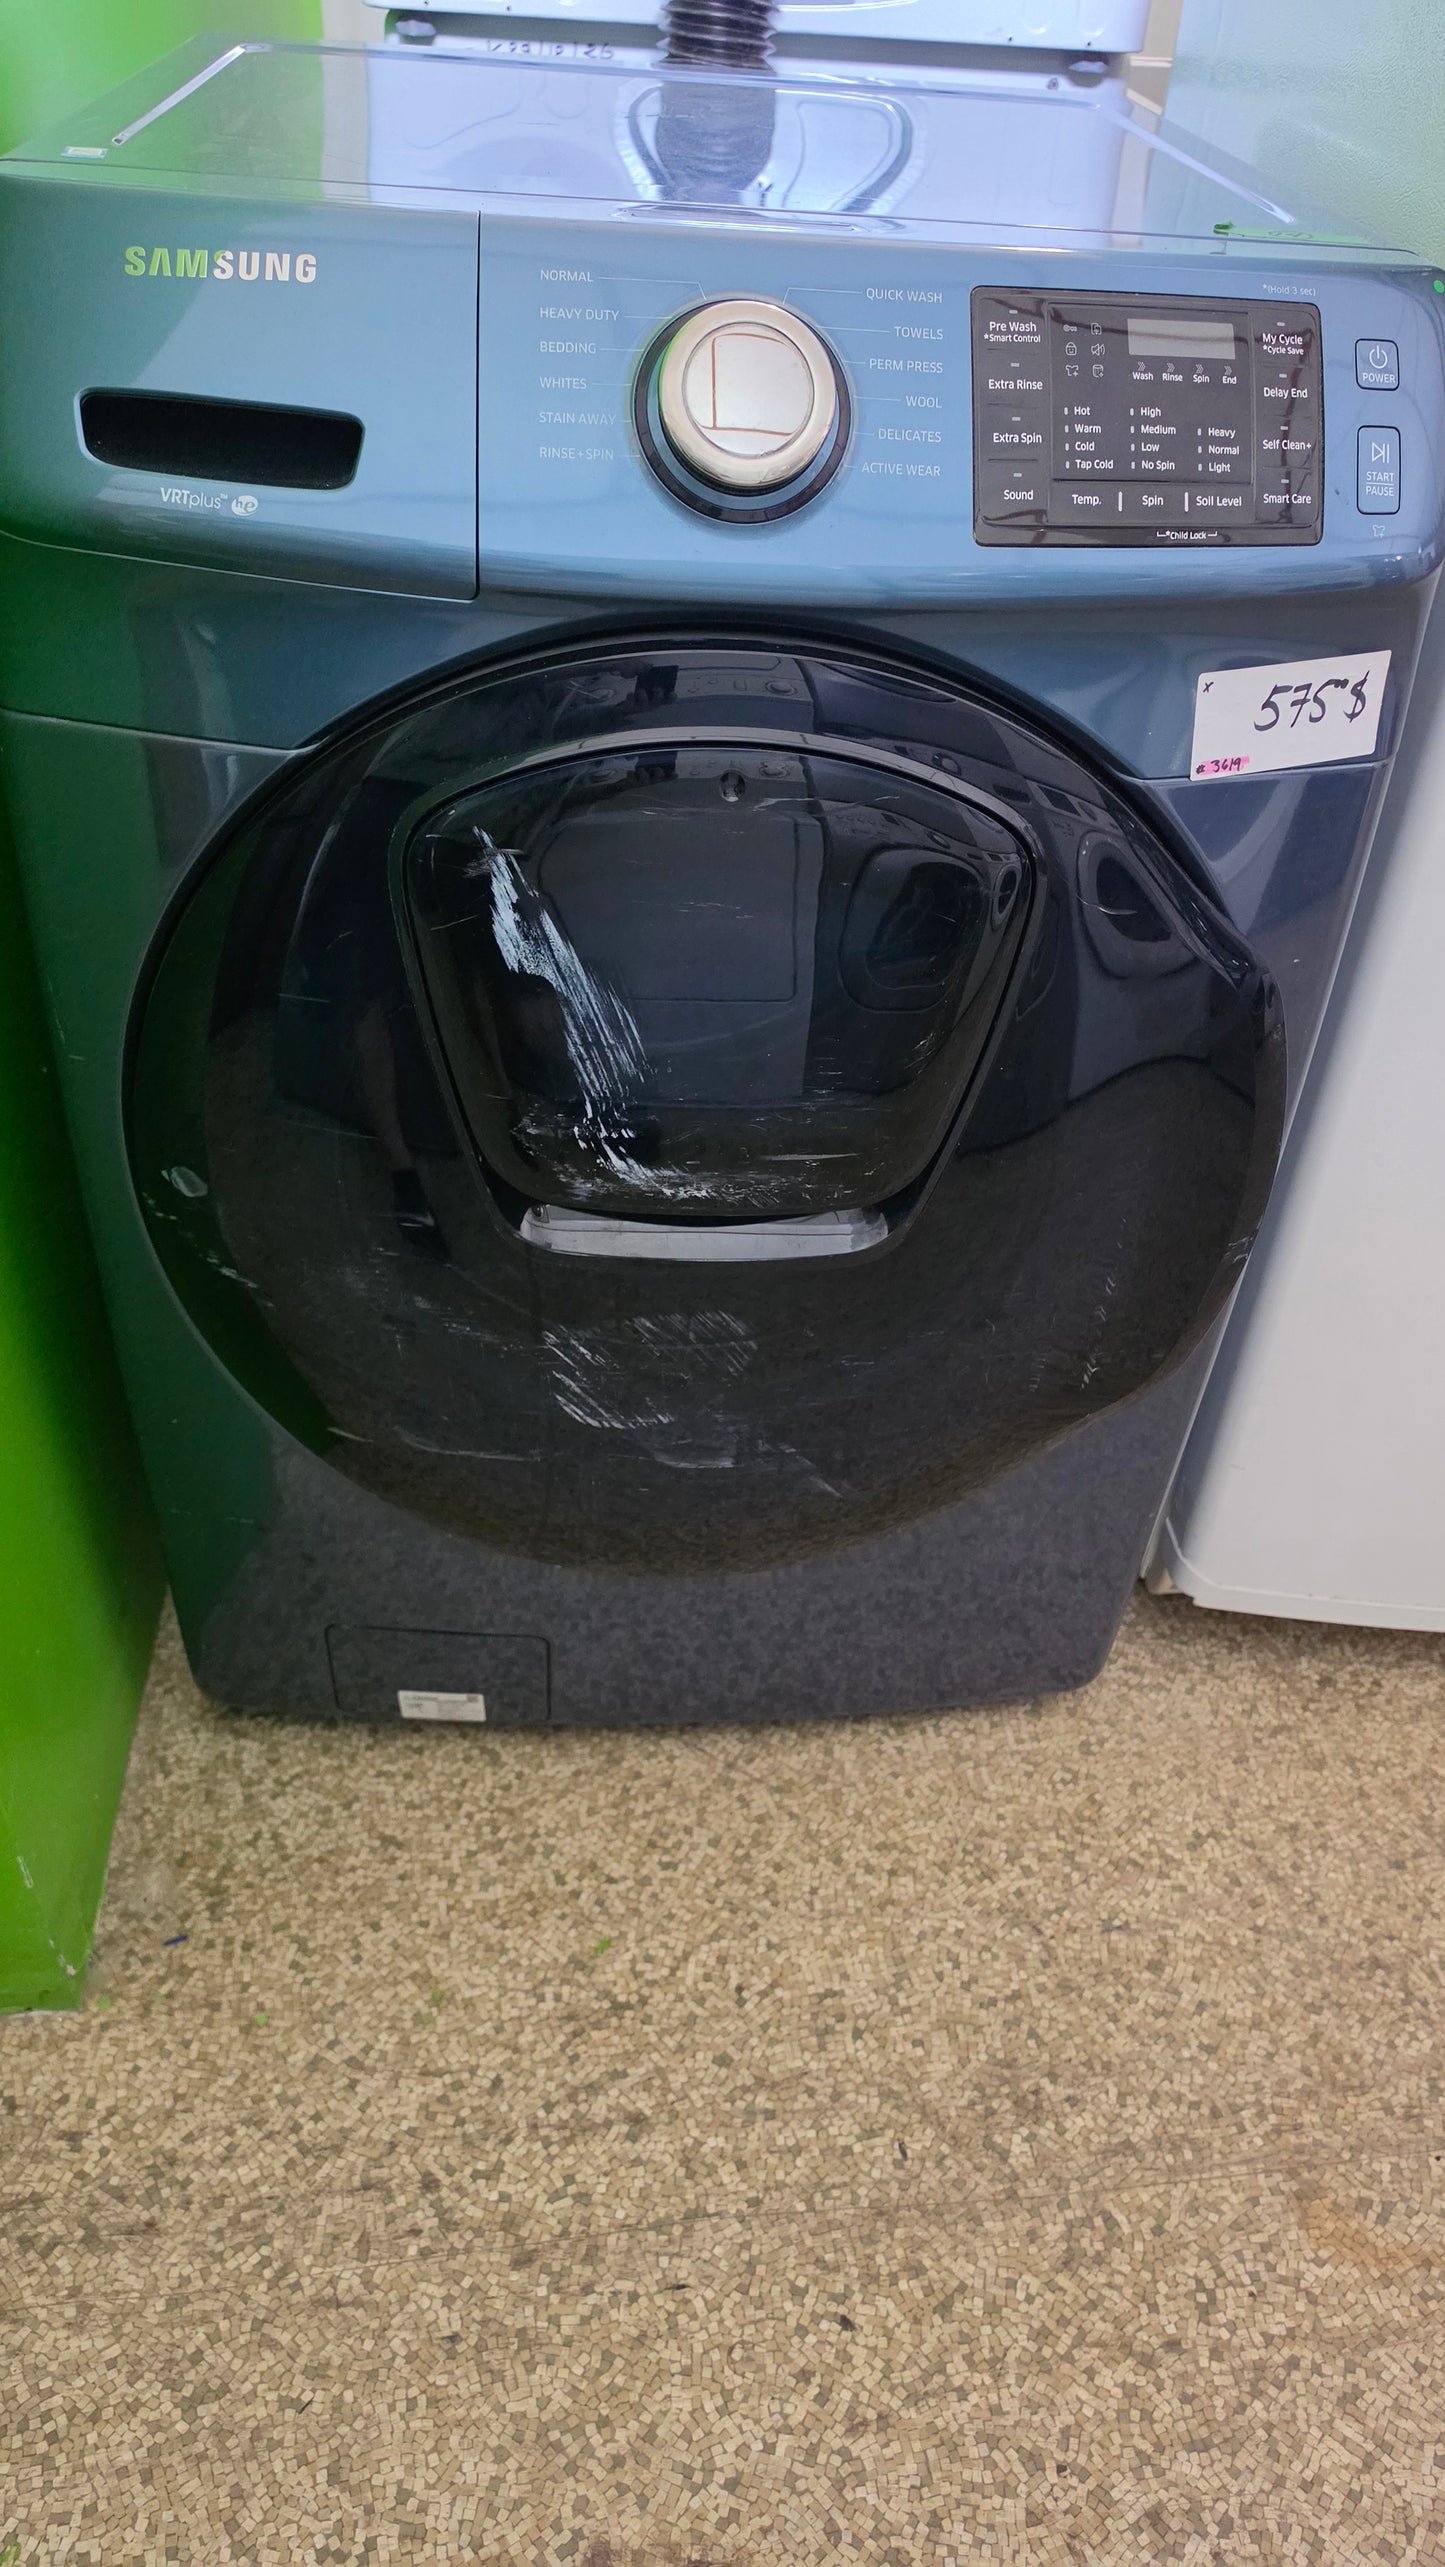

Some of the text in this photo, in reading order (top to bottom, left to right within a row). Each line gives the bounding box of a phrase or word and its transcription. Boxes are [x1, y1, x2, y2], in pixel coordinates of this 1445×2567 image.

[124, 246, 317, 283] SAMSUNG
[540, 269, 594, 283] NORMAL
[866, 287, 943, 304] QUICK WASH
[1292, 286, 1298, 295] 3
[540, 307, 619, 321] HEAVY DUTY
[989, 321, 1037, 332] Pre Wash
[894, 326, 944, 340] TOWELS
[1013, 334, 1041, 343] Control
[1262, 333, 1303, 345] My Cycle
[540, 341, 597, 354] BEDDING
[1287, 346, 1304, 355] Save
[869, 358, 944, 374] PERM PRESS
[1132, 371, 1154, 381] Wash
[1162, 373, 1183, 382] Rinse
[1193, 374, 1210, 384] Spin
[1222, 376, 1237, 385] End
[1362, 372, 1396, 384] POWER
[540, 376, 588, 390] WHITES
[988, 379, 1043, 390] Extra Rinse
[1263, 387, 1308, 400] Delay End
[905, 395, 943, 409] WOOL
[1073, 406, 1091, 416] Hot
[1140, 407, 1162, 418] High
[539, 411, 617, 425] STAIN AWAY
[1074, 424, 1102, 434] Warm
[1140, 425, 1177, 435] Medium
[1208, 427, 1236, 439] Heavy
[878, 428, 942, 443] DELICATES
[993, 432, 1042, 445] Extra Spin
[1075, 442, 1095, 452] Cold
[1141, 442, 1160, 452] Low
[1208, 445, 1240, 455] Normal
[1262, 439, 1312, 451] Self Clean+
[861, 461, 941, 477] ACTIVE WEAR
[1075, 460, 1114, 470] Tap Cold
[1141, 460, 1176, 471] No Spin
[1208, 462, 1231, 473] Light
[1366, 471, 1395, 482] START
[1003, 489, 1034, 501] Sound
[1366, 485, 1395, 497] PAUSE
[1071, 494, 1102, 506] Temp.
[1142, 495, 1164, 507] Spin
[1196, 495, 1242, 507] Soil Level
[1263, 493, 1312, 505] Smart Care
[1189, 531, 1207, 540] Lock
[1211, 757, 1242, 773] 3619
